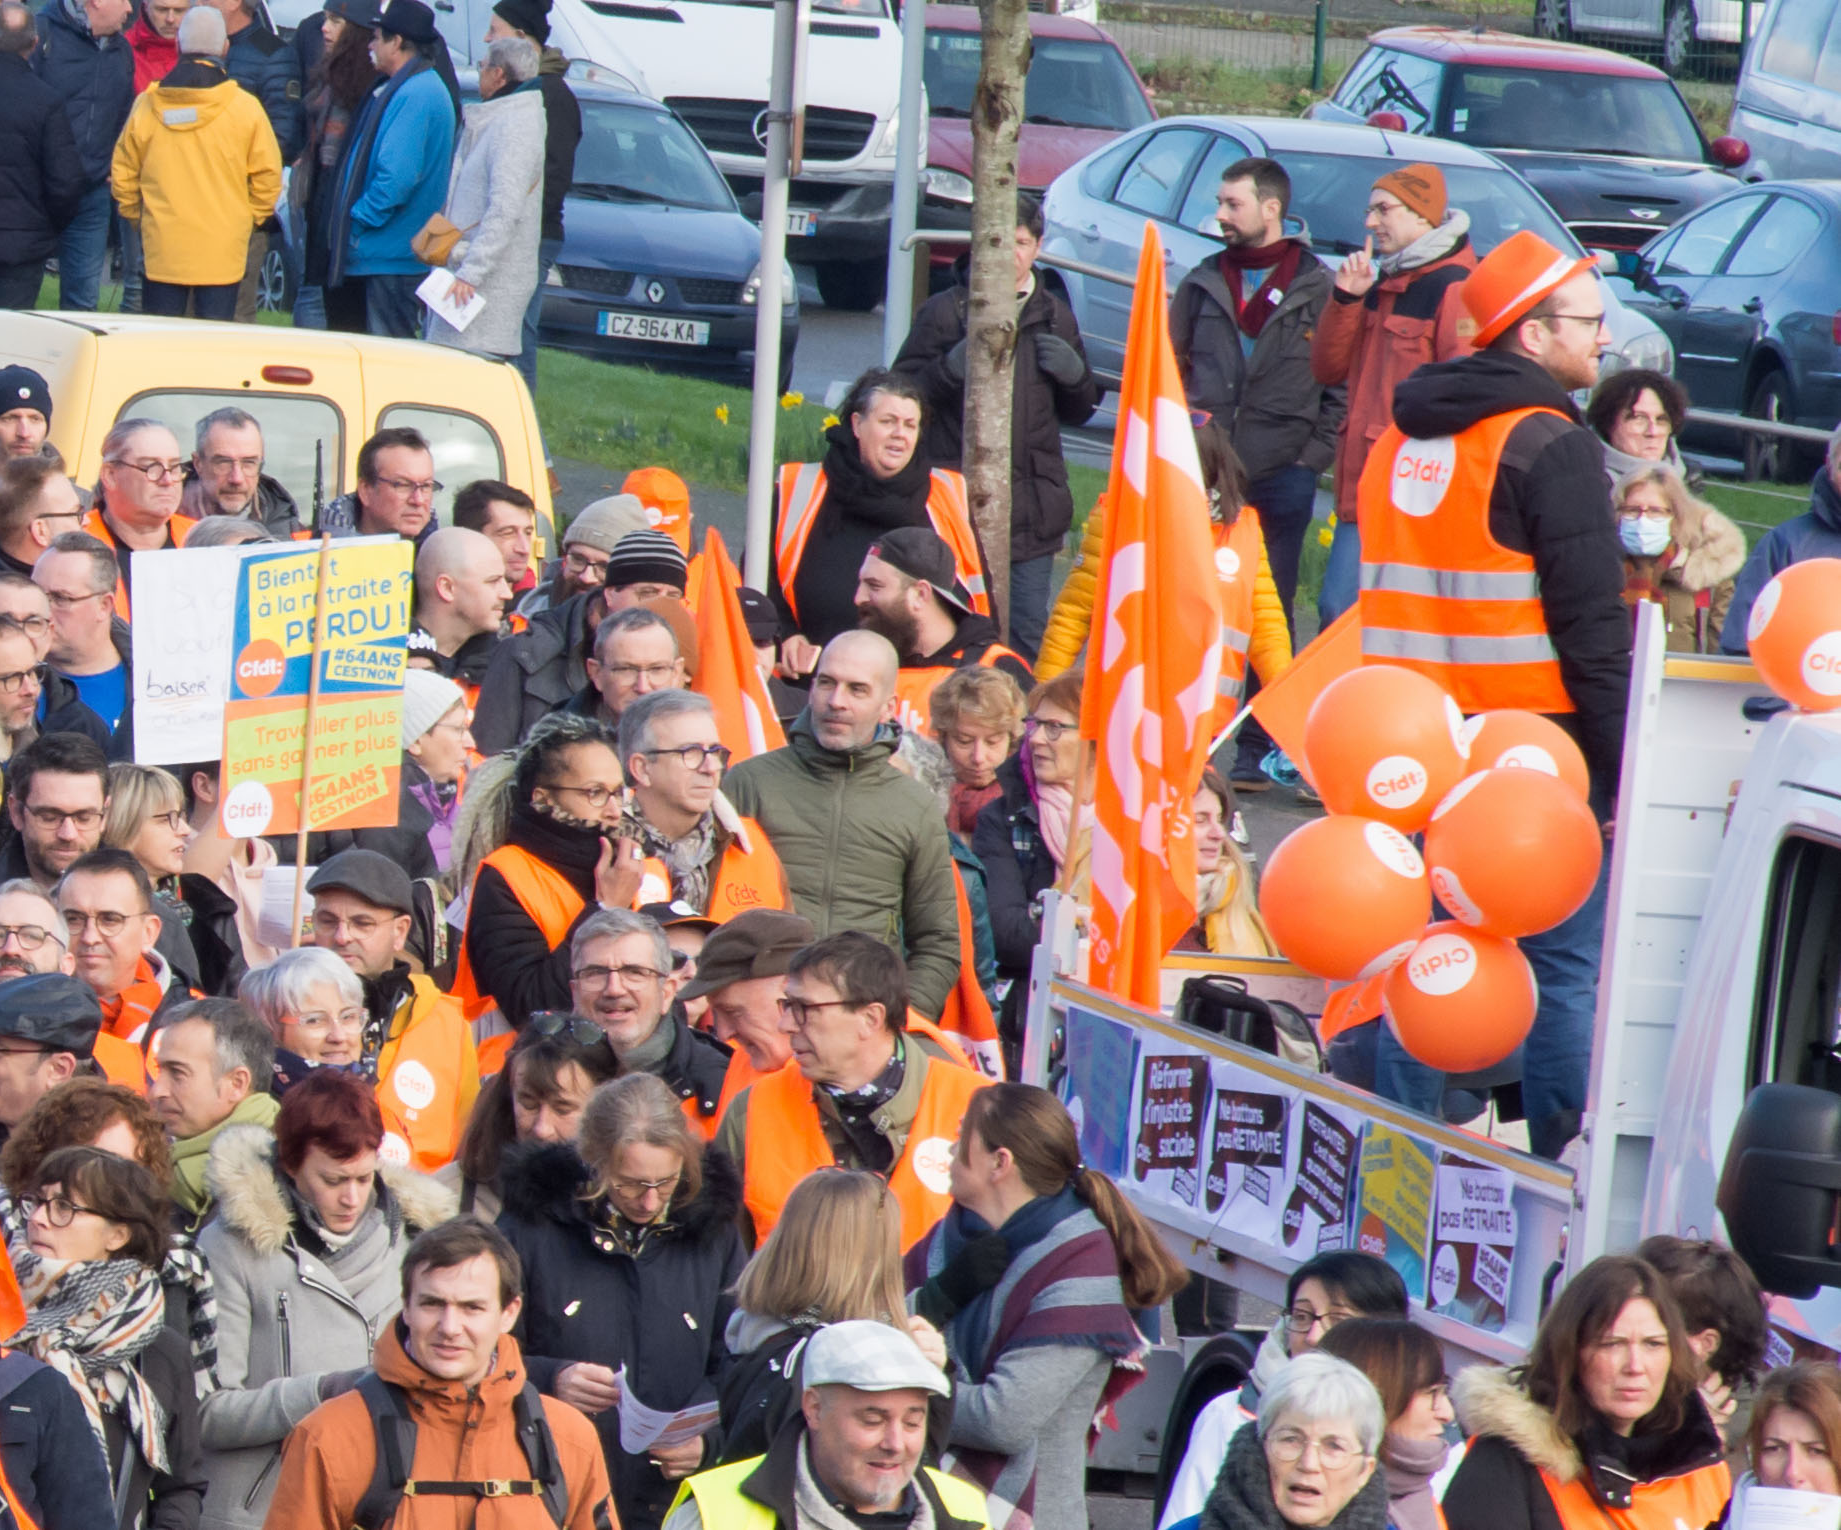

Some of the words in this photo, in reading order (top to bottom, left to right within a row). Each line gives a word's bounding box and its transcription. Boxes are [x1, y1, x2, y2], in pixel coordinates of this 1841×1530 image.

[1397, 455, 1449, 485] Cfdt:
[257, 557, 339, 591] Bientt
[258, 600, 272, 618] à
[277, 594, 296, 615] la
[238, 657, 285, 679] Cfdt:
[333, 648, 403, 669] #64ANS
[333, 664, 397, 682] CESTNON
[231, 755, 275, 777] sans
[279, 741, 350, 771] ganer
[354, 734, 398, 758] plus
[1371, 770, 1425, 797] Cfdt:
[227, 803, 269, 820] Cfdt:
[308, 781, 379, 825] CESTNON
[1412, 946, 1470, 980] Cfdt:
[1232, 1127, 1282, 1155] RETRAITE
[1460, 1176, 1474, 1201] Ne
[1440, 1211, 1461, 1233] pas
[1462, 1206, 1512, 1234] RETRAITE
